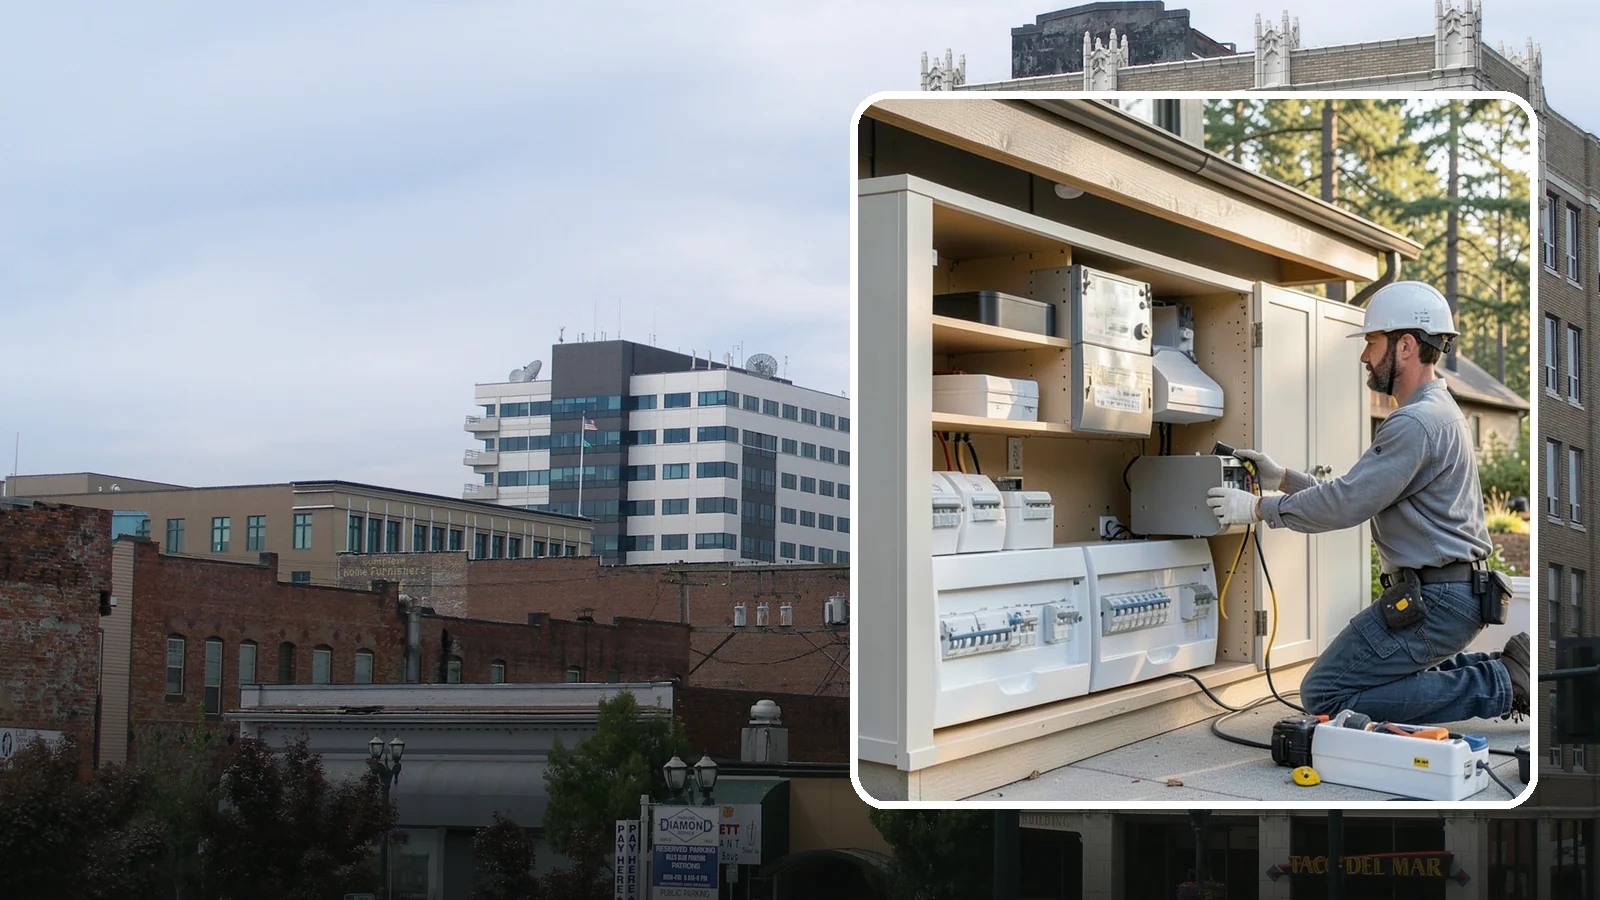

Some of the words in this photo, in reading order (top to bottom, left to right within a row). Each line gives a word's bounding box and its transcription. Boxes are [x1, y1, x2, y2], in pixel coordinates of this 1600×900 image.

[370, 566, 427, 576] Furnishers
[660, 818, 713, 832] DIAMOND
[1022, 815, 1070, 827] BUILDING
[617, 825, 625, 852] PAY
[628, 824, 637, 852] PAY
[656, 845, 688, 853] RESERVED
[689, 846, 716, 854] PARKING
[721, 851, 739, 862] Soup
[671, 862, 701, 870] PATRONS
[1288, 855, 1329, 873] TAC
[1346, 856, 1385, 875] DEL
[1392, 857, 1442, 877] MAR
[617, 856, 625, 894] HERE
[628, 856, 637, 893] HERE
[660, 889, 682, 897] PUBLIC
[683, 890, 710, 898] PARKING
